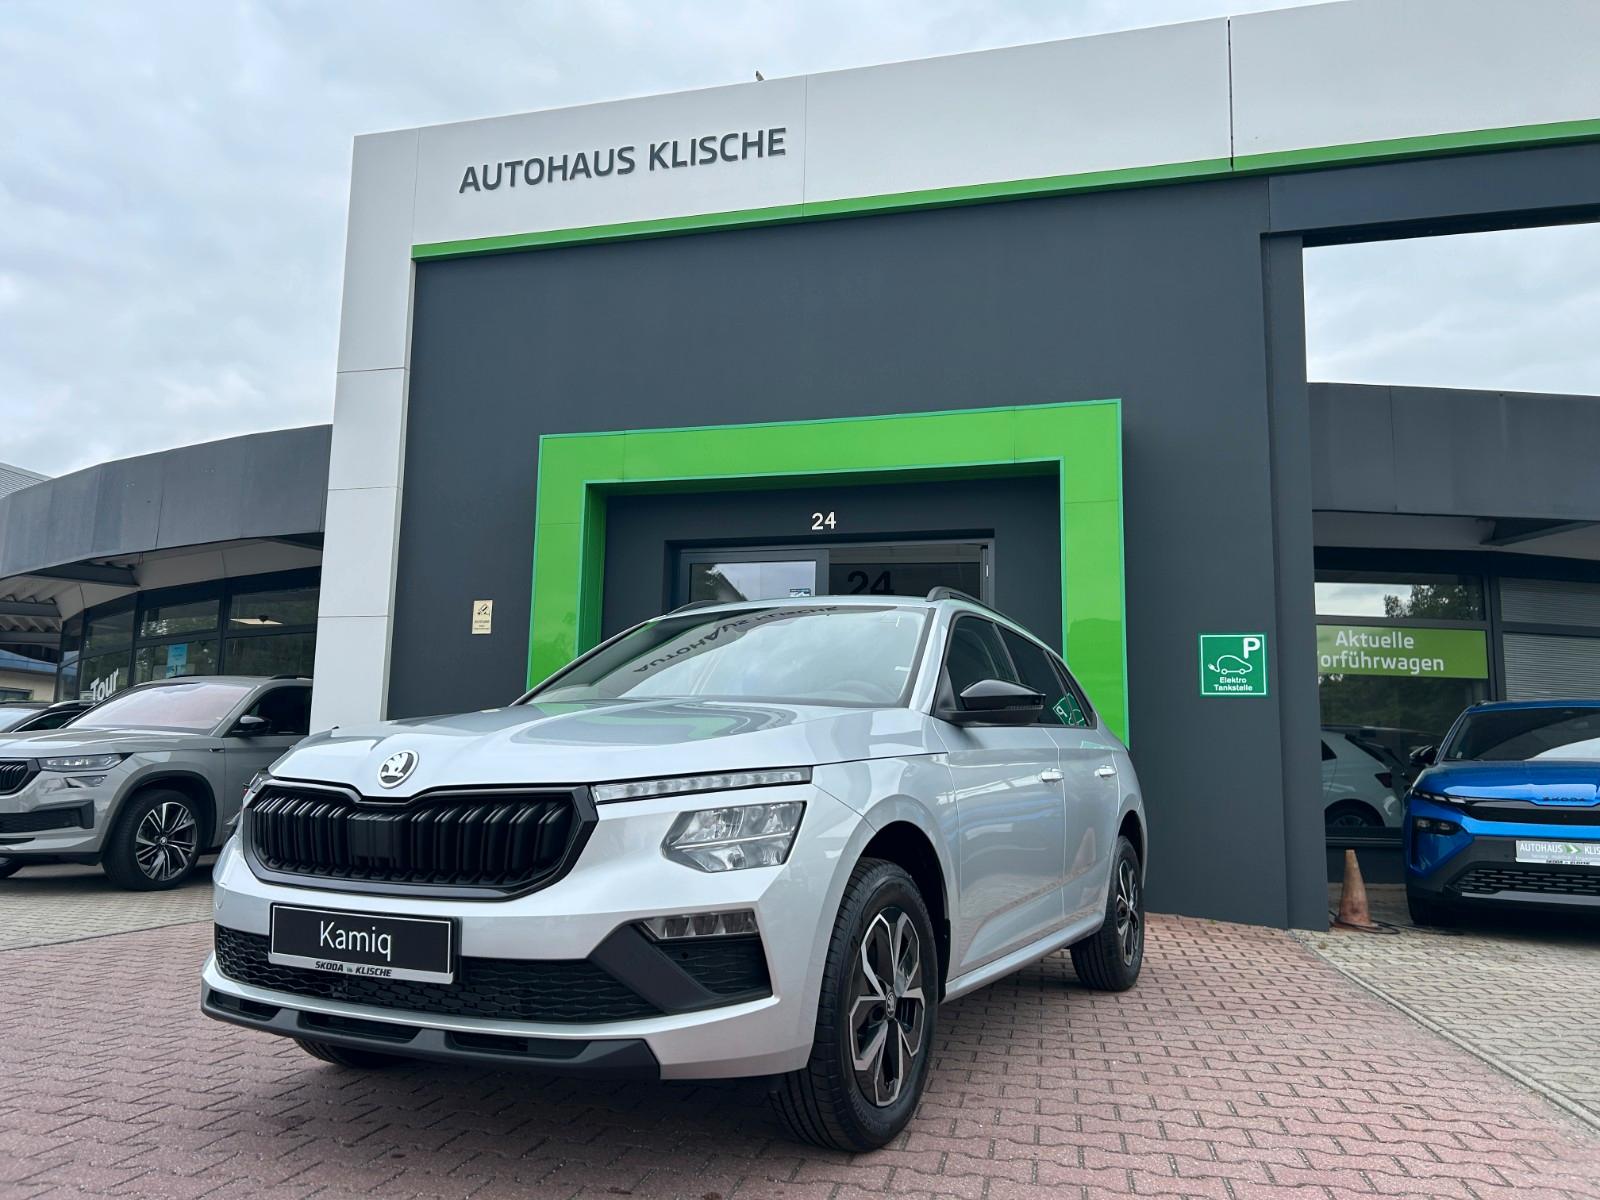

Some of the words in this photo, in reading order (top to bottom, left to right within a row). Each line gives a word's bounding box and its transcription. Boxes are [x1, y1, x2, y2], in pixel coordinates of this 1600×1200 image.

[459, 146, 635, 194] AUTOHAUS
[649, 127, 787, 171] KLISCHE
[811, 511, 837, 530] 24
[847, 570, 896, 596] 24
[1243, 637, 1261, 659] P
[1335, 630, 1415, 649] Aktuelle
[1318, 650, 1445, 675] orführwagen
[90, 667, 119, 701] Tour
[1213, 684, 1253, 692] Tankstelle
[1219, 676, 1247, 684] Elektro
[1519, 842, 1563, 853] AUTOHAUS
[319, 920, 392, 962] Kamiq
[315, 960, 344, 972] SKODA
[355, 966, 393, 977] KLISCHE
